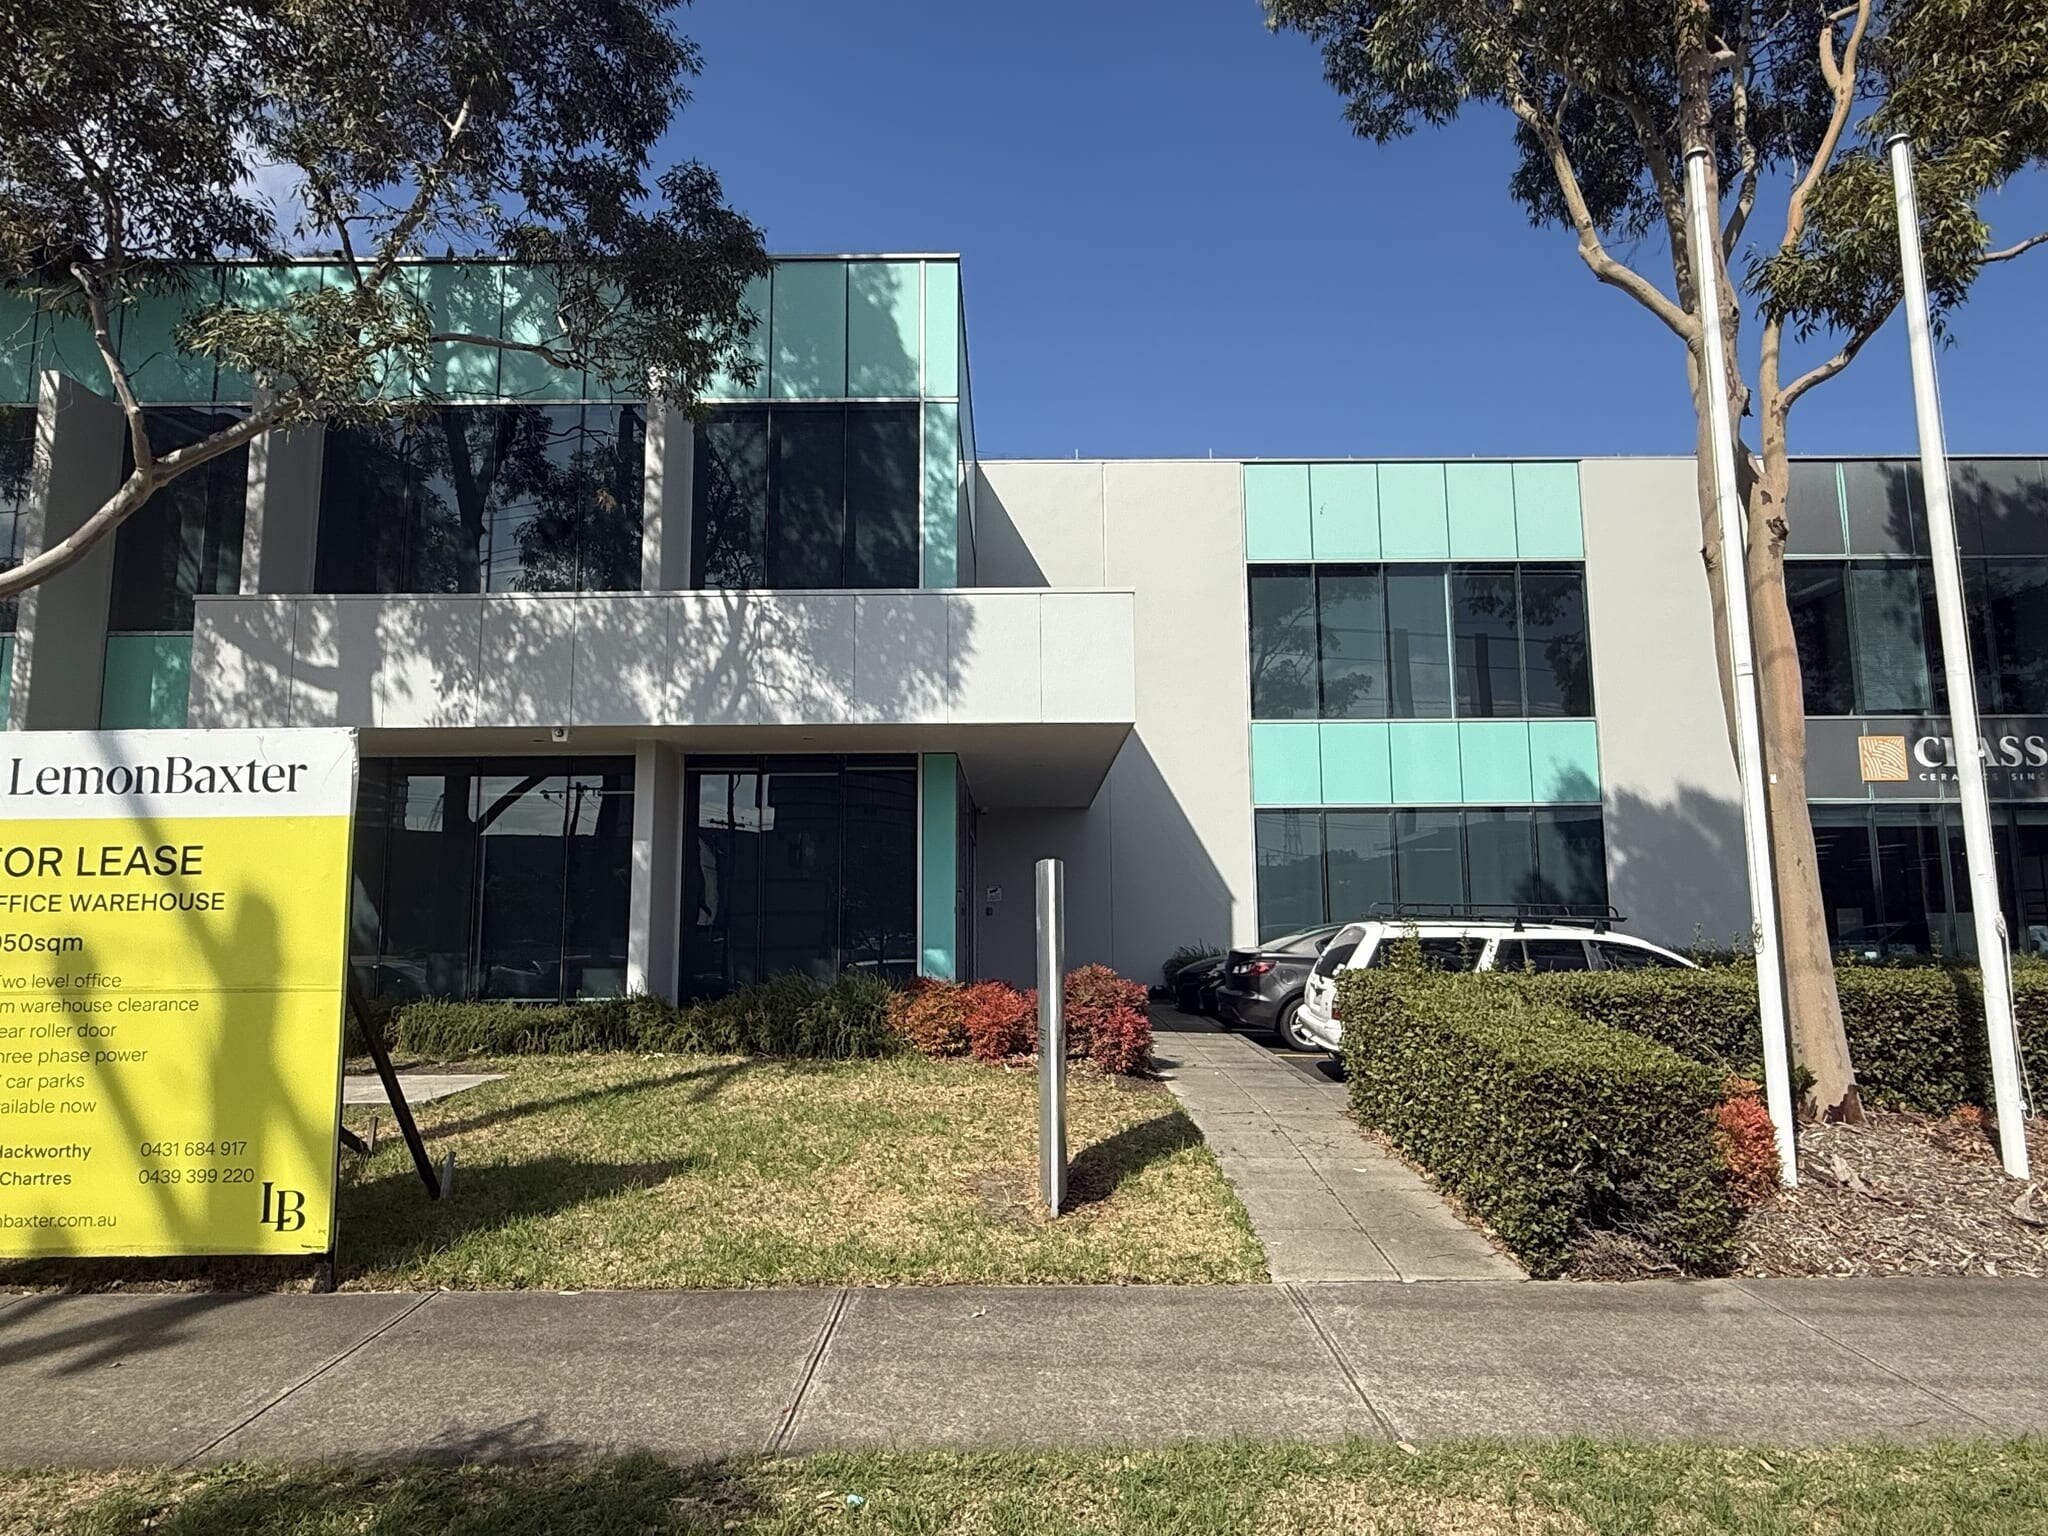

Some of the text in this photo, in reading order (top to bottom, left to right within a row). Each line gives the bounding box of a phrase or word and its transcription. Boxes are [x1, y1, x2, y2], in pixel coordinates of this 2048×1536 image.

[8, 756, 308, 796] LemonBaxter
[0, 845, 204, 877] OR LEASE
[69, 892, 225, 912] WAREHOUSE
[0, 933, 84, 956] 50sqm
[0, 973, 122, 989] wo level office
[20, 998, 112, 1013] warehouse
[117, 998, 199, 1012] clearance
[30, 1023, 73, 1038] roller
[77, 1022, 117, 1037] door
[38, 1048, 90, 1066] phase
[95, 1050, 148, 1066] power
[6, 1073, 85, 1091] car parks
[0, 1098, 97, 1113] ailable now
[140, 1142, 179, 1157] 0431
[184, 1142, 215, 1156] 684
[220, 1141, 248, 1155] 917
[0, 1168, 255, 1186] Chartres 0439 399 220
[0, 1214, 117, 1228] baxter.com.au
